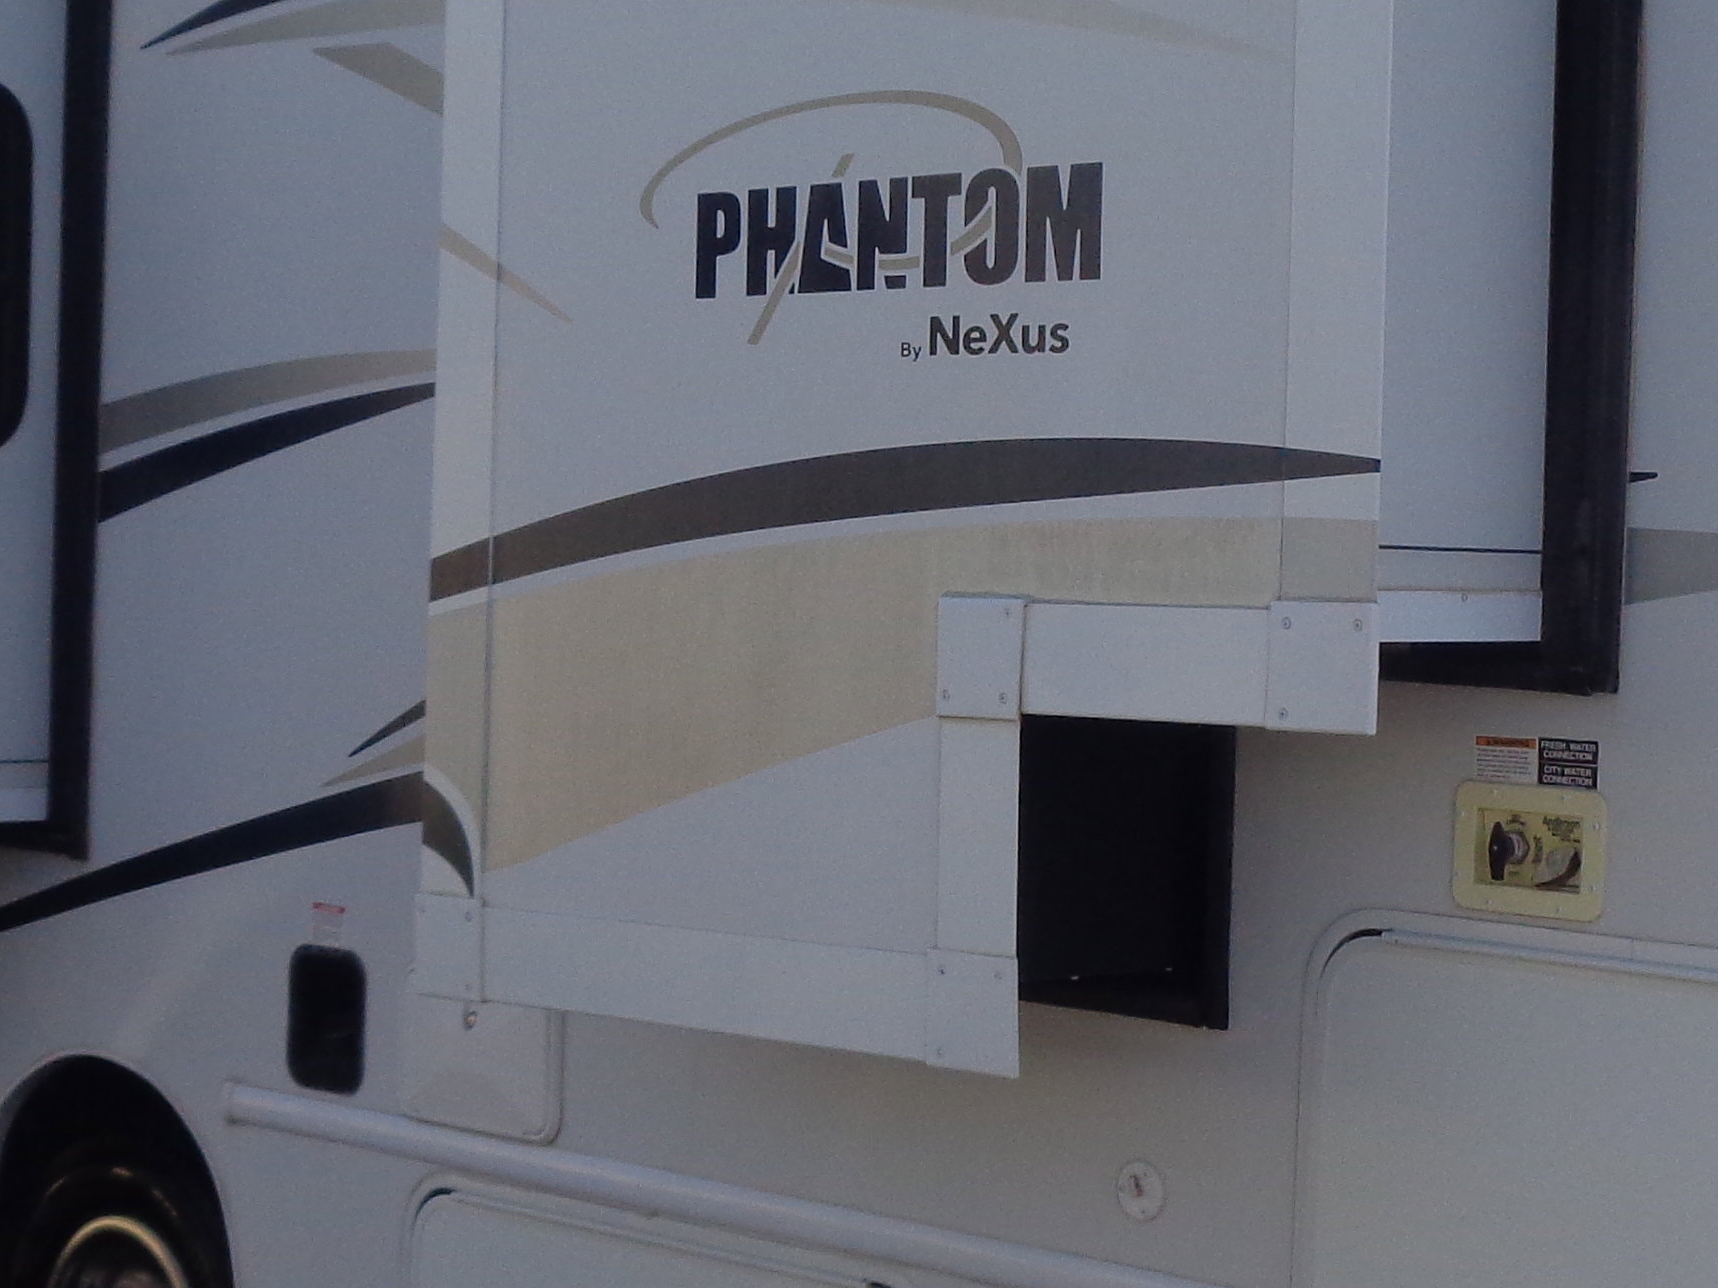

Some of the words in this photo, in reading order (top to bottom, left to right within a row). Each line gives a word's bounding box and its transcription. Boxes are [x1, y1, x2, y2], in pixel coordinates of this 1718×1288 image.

[695, 162, 1104, 299] PHANTOM
[900, 342, 922, 362] By
[928, 313, 1070, 357] NeXus
[1540, 740, 1566, 750] FRESH
[1569, 742, 1597, 752] WATER
[1543, 750, 1594, 761] CONNECTION
[1543, 765, 1562, 775] CITY
[1564, 766, 1592, 777] WATER
[1542, 775, 1593, 787] CONNECTION
